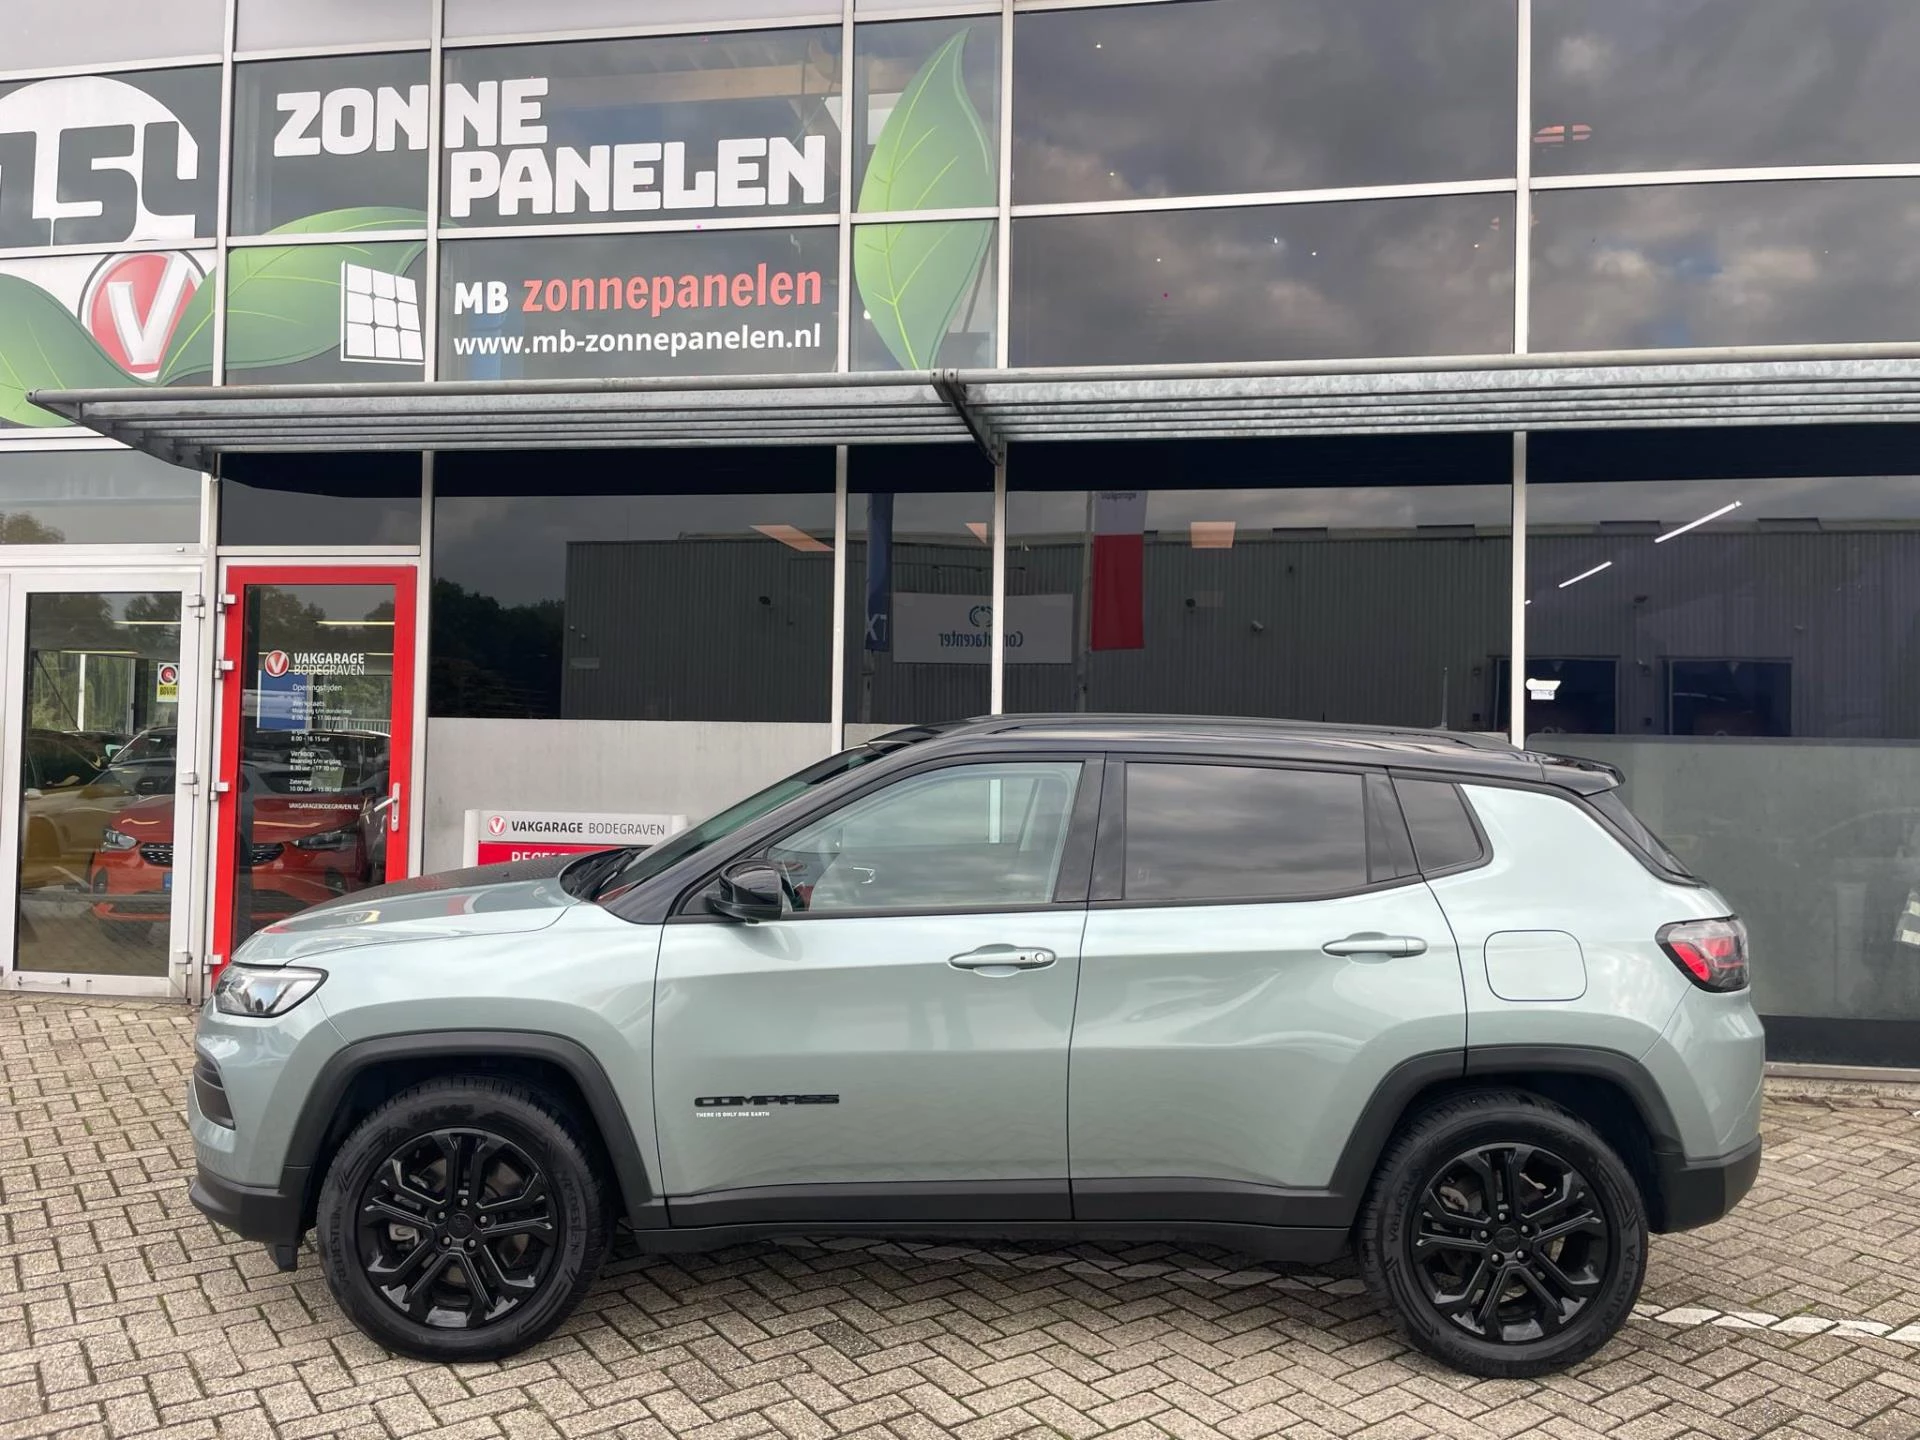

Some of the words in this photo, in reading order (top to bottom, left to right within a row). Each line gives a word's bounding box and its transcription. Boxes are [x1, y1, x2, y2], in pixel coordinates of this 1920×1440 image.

[274, 77, 549, 157] ZONNE
[450, 135, 826, 217] PANELEN
[453, 280, 509, 316] MB
[522, 262, 822, 319] zonnepanelen
[453, 322, 822, 358] www.mb-zonnepanelen.nl
[293, 652, 365, 665] VAKGARAGE
[293, 664, 365, 676] BODEGRAVEN
[292, 683, 343, 693] Openingstijden
[511, 820, 584, 834] VAKGARAGE
[588, 822, 665, 836] BODEGRAVEN
[695, 1094, 840, 1107] COMPASS
